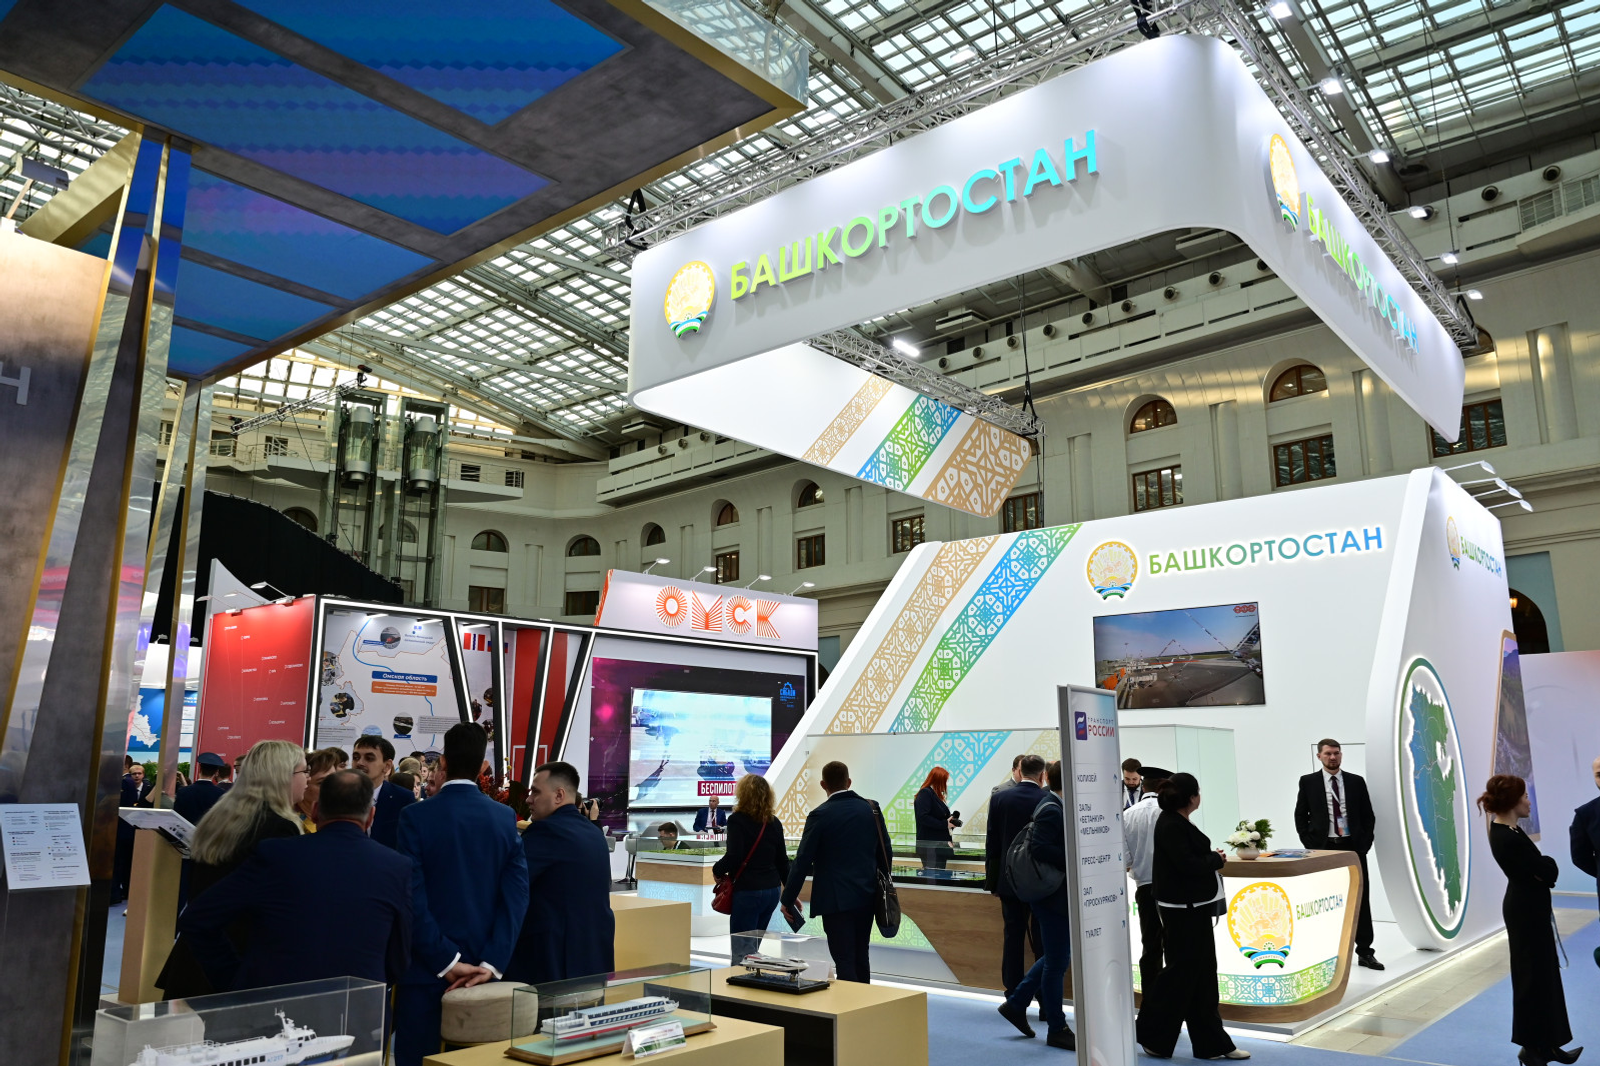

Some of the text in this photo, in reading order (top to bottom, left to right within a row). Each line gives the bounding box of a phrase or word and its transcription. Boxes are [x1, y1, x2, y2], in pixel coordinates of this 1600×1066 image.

[731, 129, 1098, 300] БАШКОРТОСТАН
[1306, 192, 1419, 354] БАШКОРТОСТАН
[1149, 527, 1383, 574] БАШКОРТОСТАН
[1460, 536, 1502, 578] БАШКОРТОСТАН
[656, 585, 781, 639] ОМСК
[405, 674, 428, 682] область
[1087, 717, 1114, 725] ТРАНСПОРТ
[1088, 725, 1115, 738] РОССИИ
[1077, 773, 1098, 783] КОЛИЗЕЙ
[1079, 804, 1092, 812] ЗАЛЫ
[1081, 854, 1111, 865] ПРЕСС-ЦЕНТР
[1083, 886, 1093, 896] ЗАЛ
[1296, 894, 1343, 920] БАШКОРТОСТАН
[1085, 927, 1102, 939] ТУАЛЕТ
